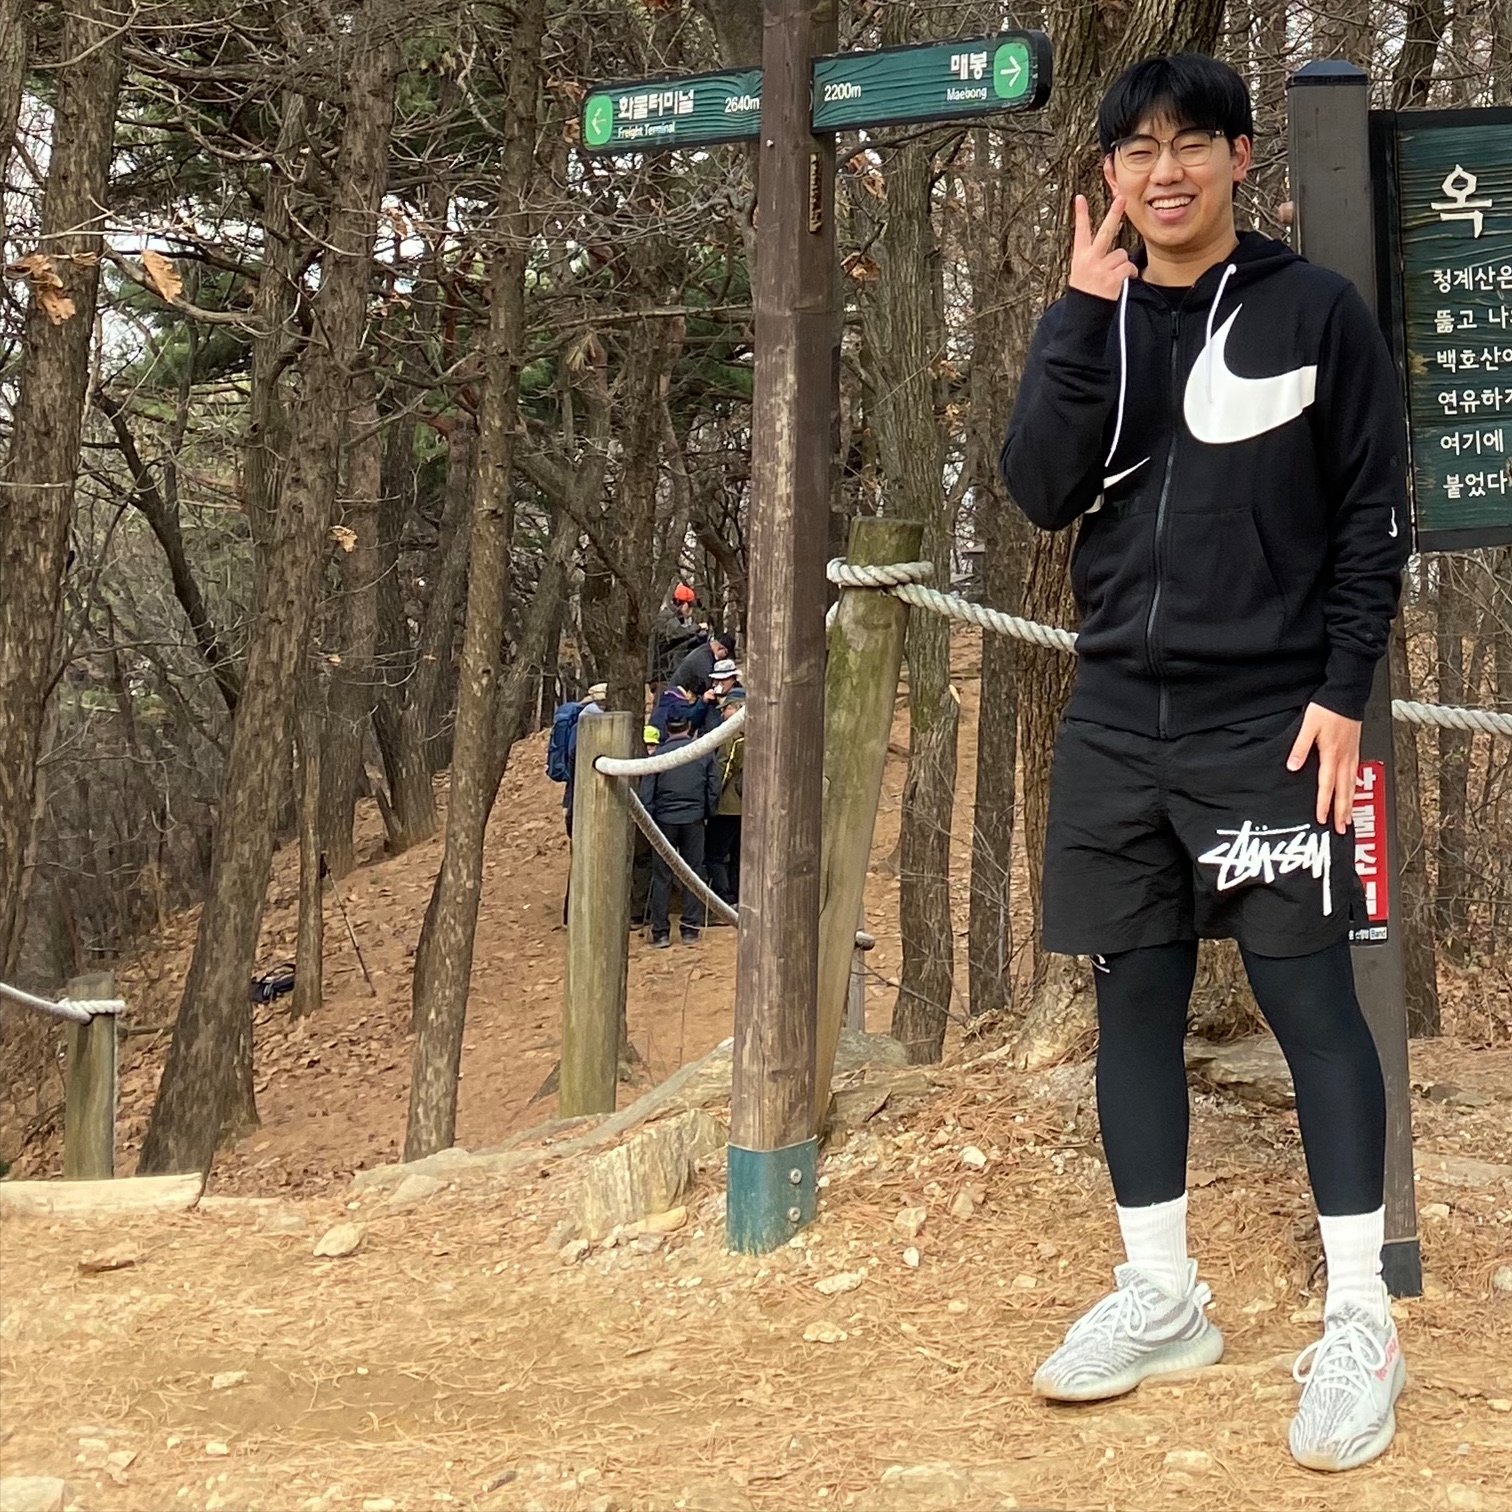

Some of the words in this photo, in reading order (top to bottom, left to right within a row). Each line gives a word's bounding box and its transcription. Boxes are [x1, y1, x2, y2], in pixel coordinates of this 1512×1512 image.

[951, 51, 987, 80] 매봉
[725, 95, 760, 113] 2640m
[824, 83, 862, 101] 2200m
[947, 87, 987, 101] Maebong
[618, 90, 694, 120] 화물터미널
[618, 125, 643, 139] Freight
[645, 121, 675, 136] Terminal
[1434, 310, 1477, 333] 뚫고
[1441, 429, 1503, 455] 여기에
[1443, 470, 1507, 498] 붙었다
[1352, 767, 1377, 915] 산불조
